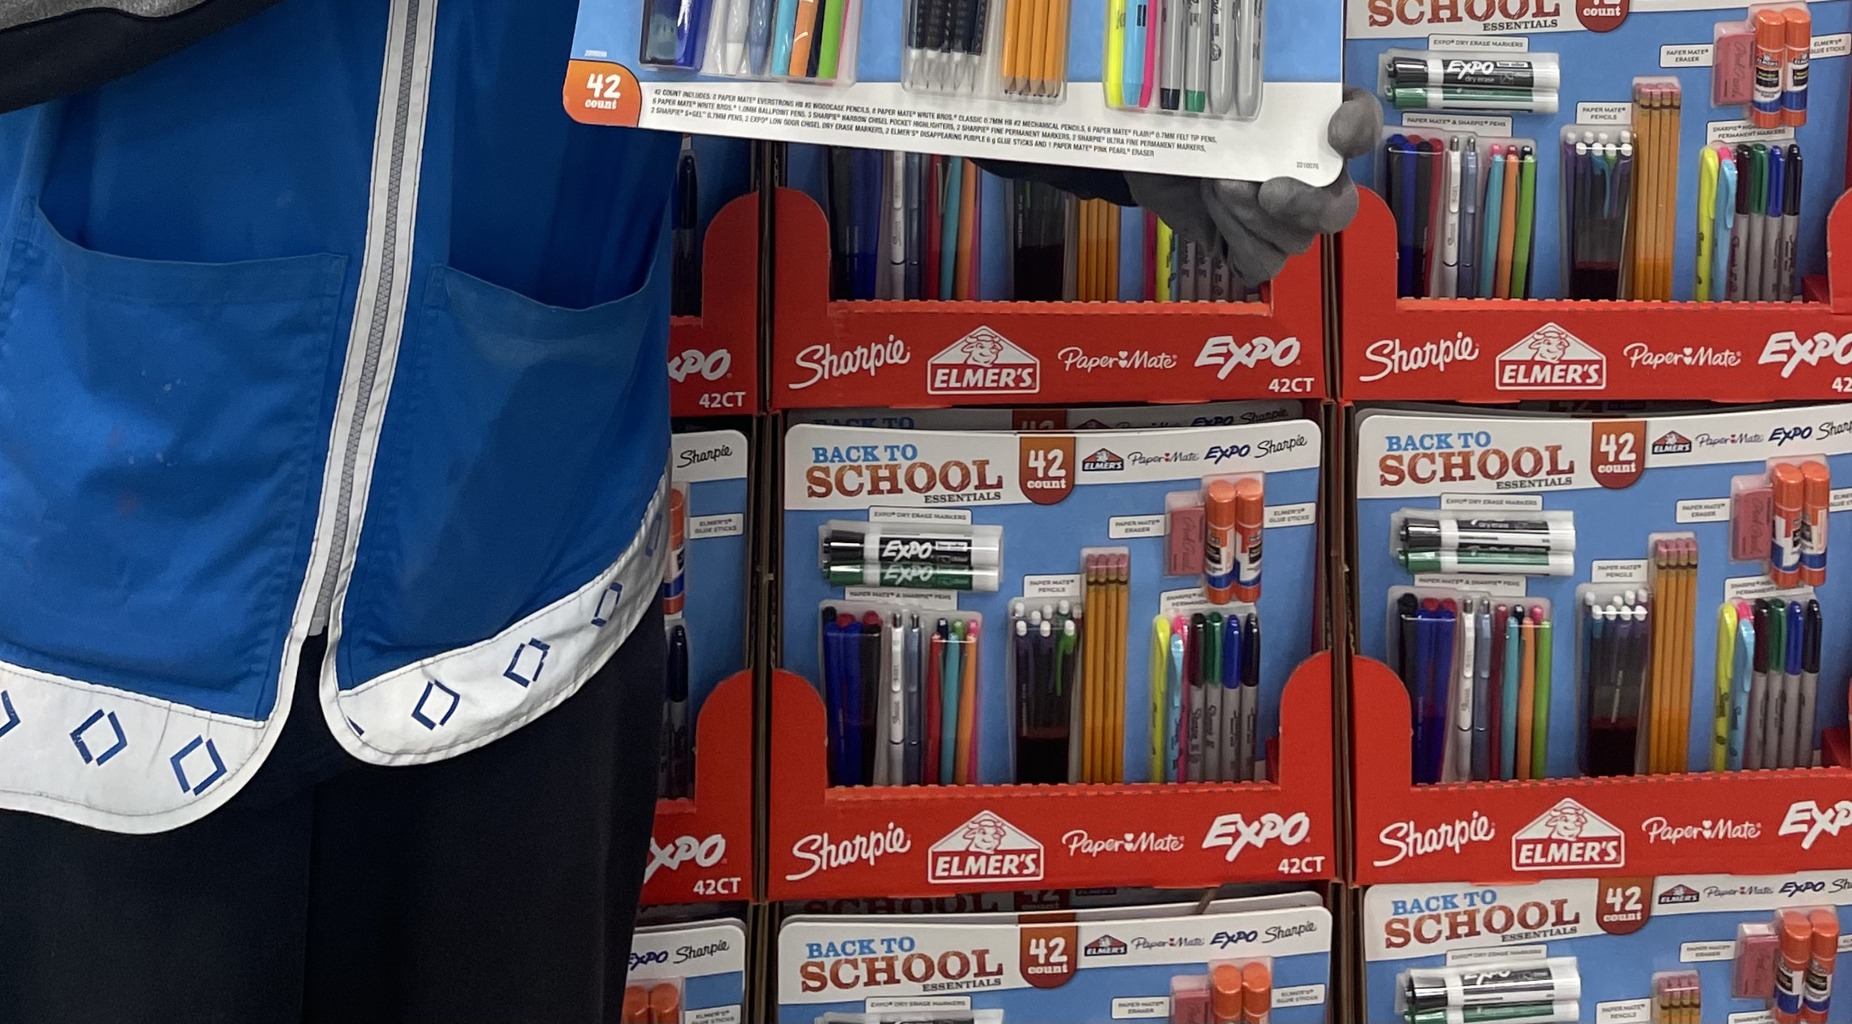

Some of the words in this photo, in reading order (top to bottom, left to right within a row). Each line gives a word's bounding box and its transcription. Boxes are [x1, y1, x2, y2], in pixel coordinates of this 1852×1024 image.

[1583, 2, 1620, 16] count
[587, 74, 620, 101] 42
[585, 99, 617, 109] count
[789, 335, 910, 388] Sharpie
[1058, 347, 1116, 372] Paper
[1124, 350, 1177, 369] Mate
[1195, 336, 1302, 381] EXPO
[1359, 332, 1479, 381] Sharpie
[934, 364, 1036, 390] ELMER'S
[1269, 378, 1314, 392] 42CT
[1502, 362, 1599, 383] ELMER'S
[699, 392, 746, 408] 42CT
[812, 446, 880, 466] BACK
[884, 444, 920, 463] TO
[1028, 449, 1066, 477] 42
[806, 458, 1003, 500] SCHOOL
[1027, 475, 1066, 489] count
[922, 489, 1003, 506] ESSENTIALS
[786, 821, 911, 880] Sharpie
[1202, 812, 1312, 863] EXPO
[1374, 811, 1495, 866] Sharpie
[932, 849, 1039, 878] ELMER'S
[1278, 856, 1325, 874] 42CT
[1517, 837, 1620, 867] ELMER'S
[806, 939, 876, 960] BACK
[881, 937, 917, 954] TO
[800, 946, 1005, 994] SCHOOL
